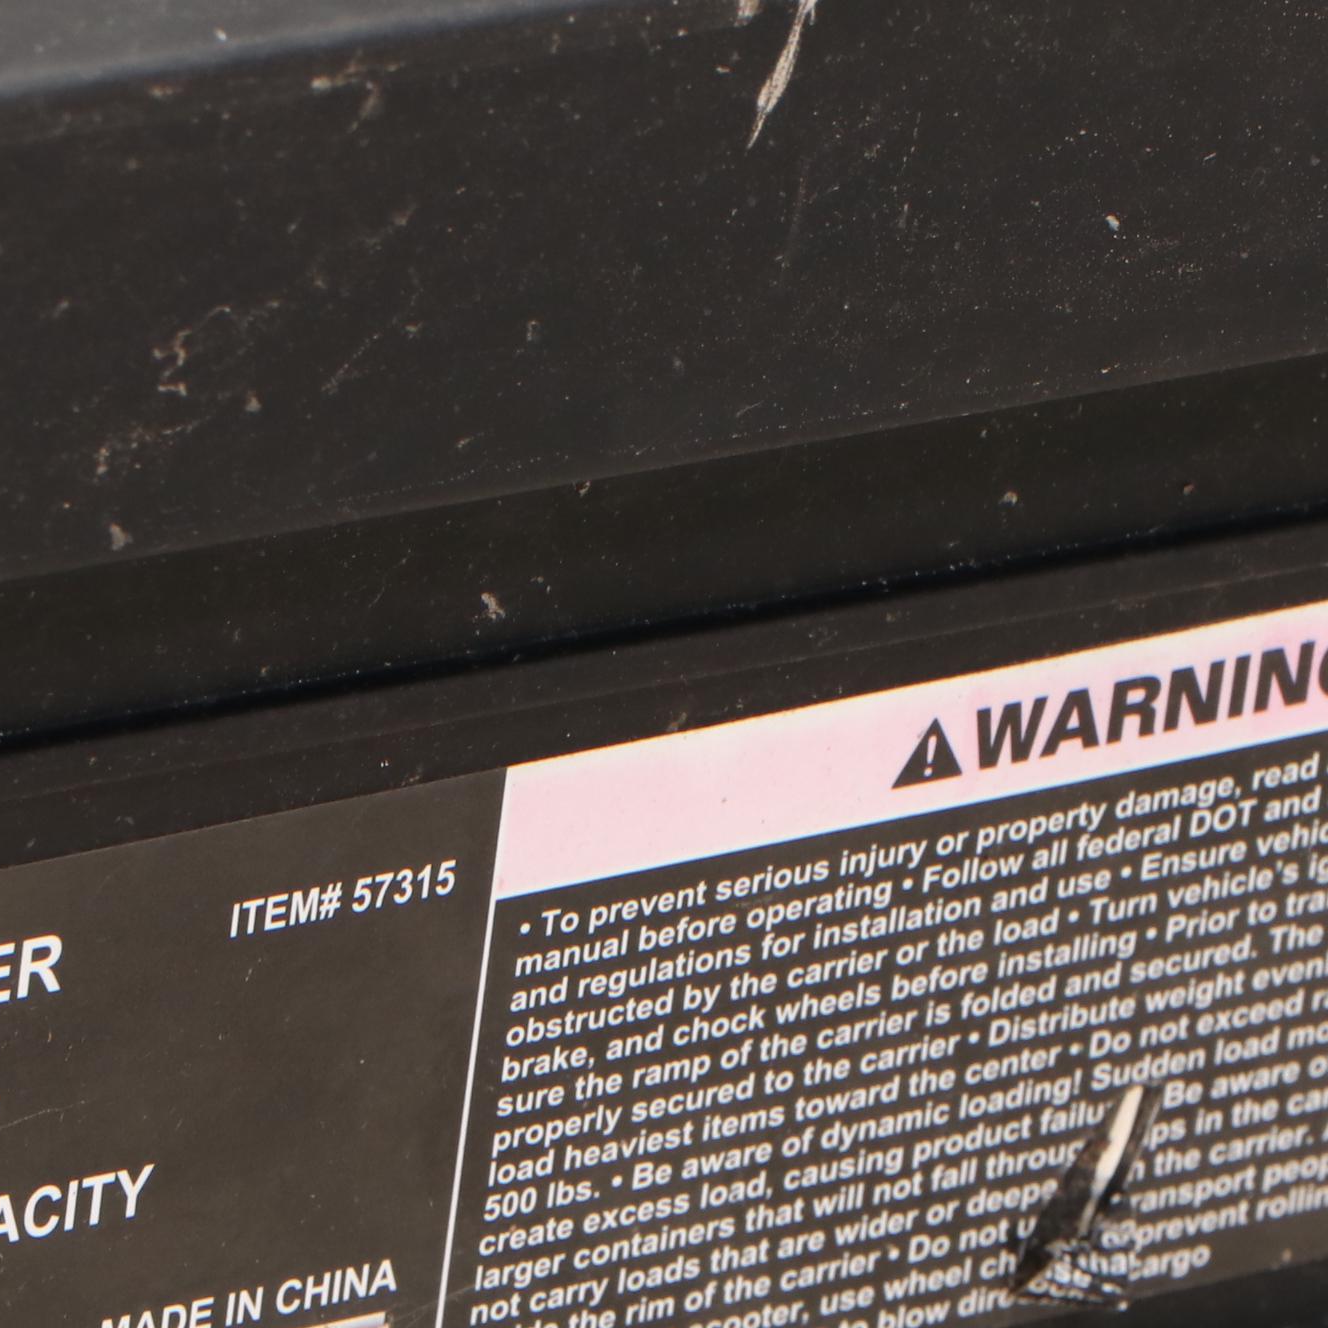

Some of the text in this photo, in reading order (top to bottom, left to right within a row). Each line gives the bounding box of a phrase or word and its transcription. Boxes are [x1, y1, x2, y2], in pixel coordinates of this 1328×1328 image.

[230, 859, 457, 938] ITEM# 57315
[510, 975, 569, 1012] and
[577, 944, 751, 999] regulations
[761, 932, 806, 960] for
[813, 896, 982, 949] installation
[990, 876, 1049, 913] and
[1057, 869, 1112, 899] use
[1140, 840, 1248, 881] Ensure
[515, 929, 629, 977] manual
[638, 913, 737, 952] before
[746, 880, 893, 932] operating
[922, 853, 1025, 893] Follow
[1031, 838, 1069, 870] all
[1076, 814, 1182, 861] federal
[1189, 798, 1258, 838] DOT
[1263, 784, 1322, 822] and
[541, 908, 580, 936] To
[588, 880, 708, 935] prevent
[715, 860, 829, 901] serious
[839, 840, 928, 878] injury
[935, 831, 970, 856] or
[975, 802, 1107, 855] property
[1114, 776, 1242, 819] damage,
[1251, 751, 1320, 791] read
[496, 1085, 565, 1117] sure
[575, 1072, 623, 1101] the
[632, 1054, 711, 1089] ramp
[720, 1038, 754, 1070] of
[760, 1033, 808, 1062] the
[816, 1010, 918, 1050] carrier
[925, 1000, 951, 1027] is
[960, 974, 1057, 1019] folded
[1064, 960, 1123, 997] and
[1129, 933, 1257, 984] secured.
[1269, 923, 1324, 954] The
[501, 1045, 595, 1083] brake,
[605, 1023, 665, 1061] and
[672, 1004, 766, 1046] chock
[775, 981, 881, 1025] wheels
[891, 962, 989, 1001] before
[997, 930, 1138, 978] installing
[1165, 908, 1241, 943] Prior
[1247, 900, 1278, 926] to
[505, 987, 675, 1047] obstructed
[683, 984, 722, 1014] by
[729, 972, 778, 1001] the
[786, 949, 889, 988] carrier
[895, 940, 930, 966] or
[937, 928, 985, 958] the
[993, 907, 1060, 946] load
[1089, 892, 1158, 925] Turn
[1167, 860, 1299, 908] vehicle's
[483, 1026, 1281, 1222] 500 lbs. Be aware of dynamic loading! Sudden load
[488, 988, 1305, 1187] load heaviest items toward the center Do not exceed
[491, 1104, 623, 1159] properly
[631, 1072, 756, 1123] secured
[764, 1069, 794, 1095] to
[803, 1057, 851, 1086] the
[859, 1034, 961, 1074] carrier
[988, 996, 1137, 1047] Distribute
[1144, 970, 1246, 1013] weight
[474, 1157, 978, 1291] larger containers that will not fall
[478, 1079, 1204, 1256] create excess load, causing product Be
[225, 1286, 264, 1327] IN
[275, 1259, 397, 1315] CHINA
[470, 1200, 960, 1326] not carry loads that are wider or
[625, 1296, 675, 1326] rim
[683, 1280, 718, 1313] of
[723, 1275, 772, 1304] the
[779, 1250, 882, 1292] carrier
[907, 1234, 951, 1264] Do
[958, 1217, 1010, 1252] not
[819, 1285, 875, 1316] use
[883, 1257, 973, 1301] wheel
